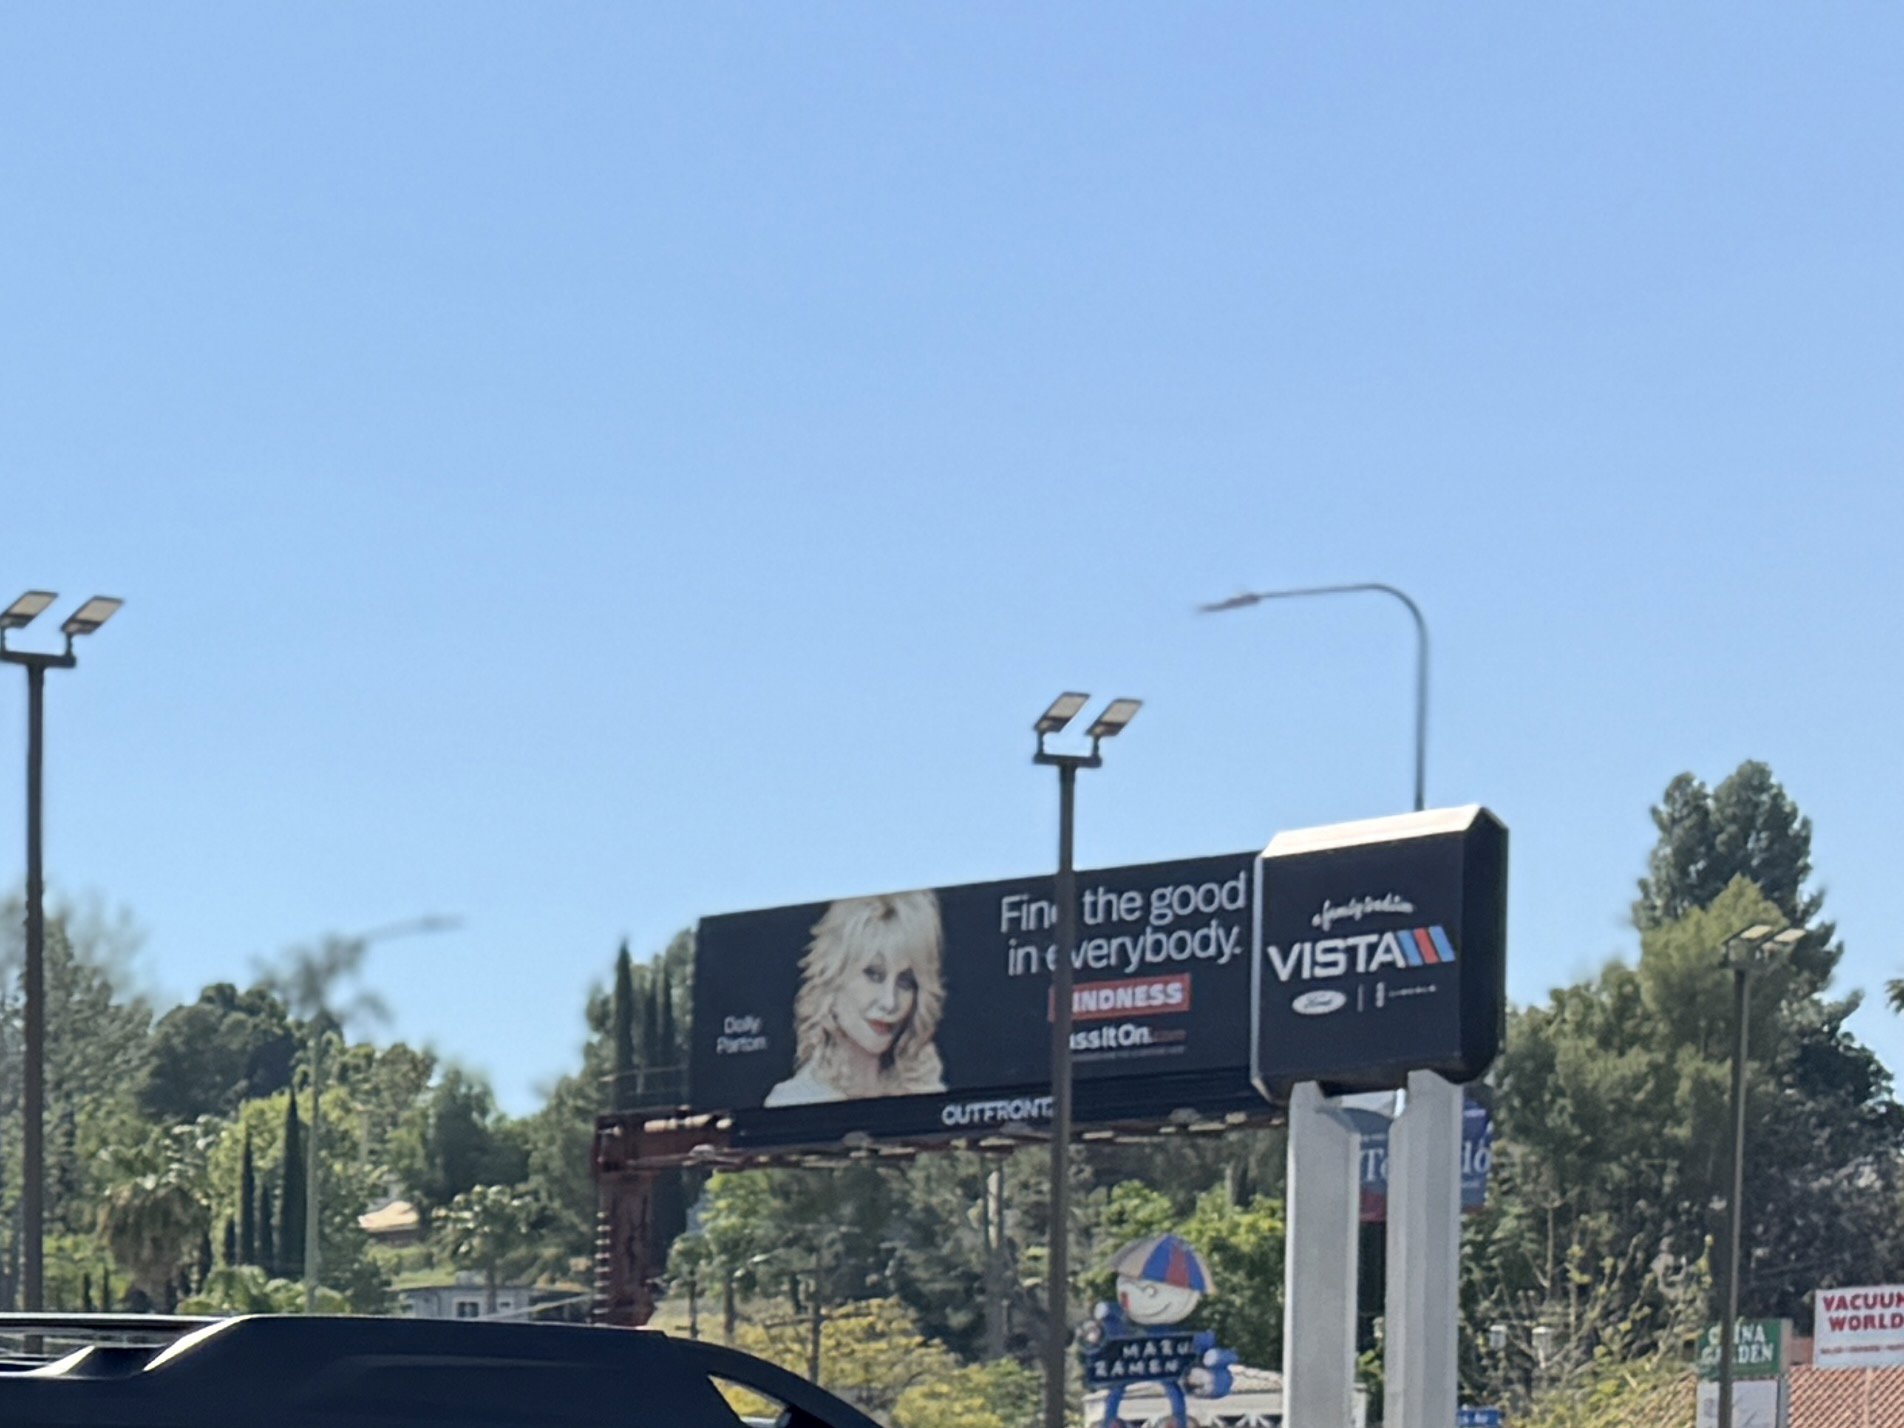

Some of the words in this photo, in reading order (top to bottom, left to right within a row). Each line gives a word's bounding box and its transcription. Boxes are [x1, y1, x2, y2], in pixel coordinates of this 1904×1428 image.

[1082, 886, 1142, 925] the
[1149, 870, 1247, 927] good
[1008, 938, 1038, 976] in
[1267, 931, 1407, 982] VISTA
[1071, 982, 1184, 1013] INDNESS
[1707, 1323, 1766, 1345] CINA
[1828, 1312, 1904, 1332] WORLD
